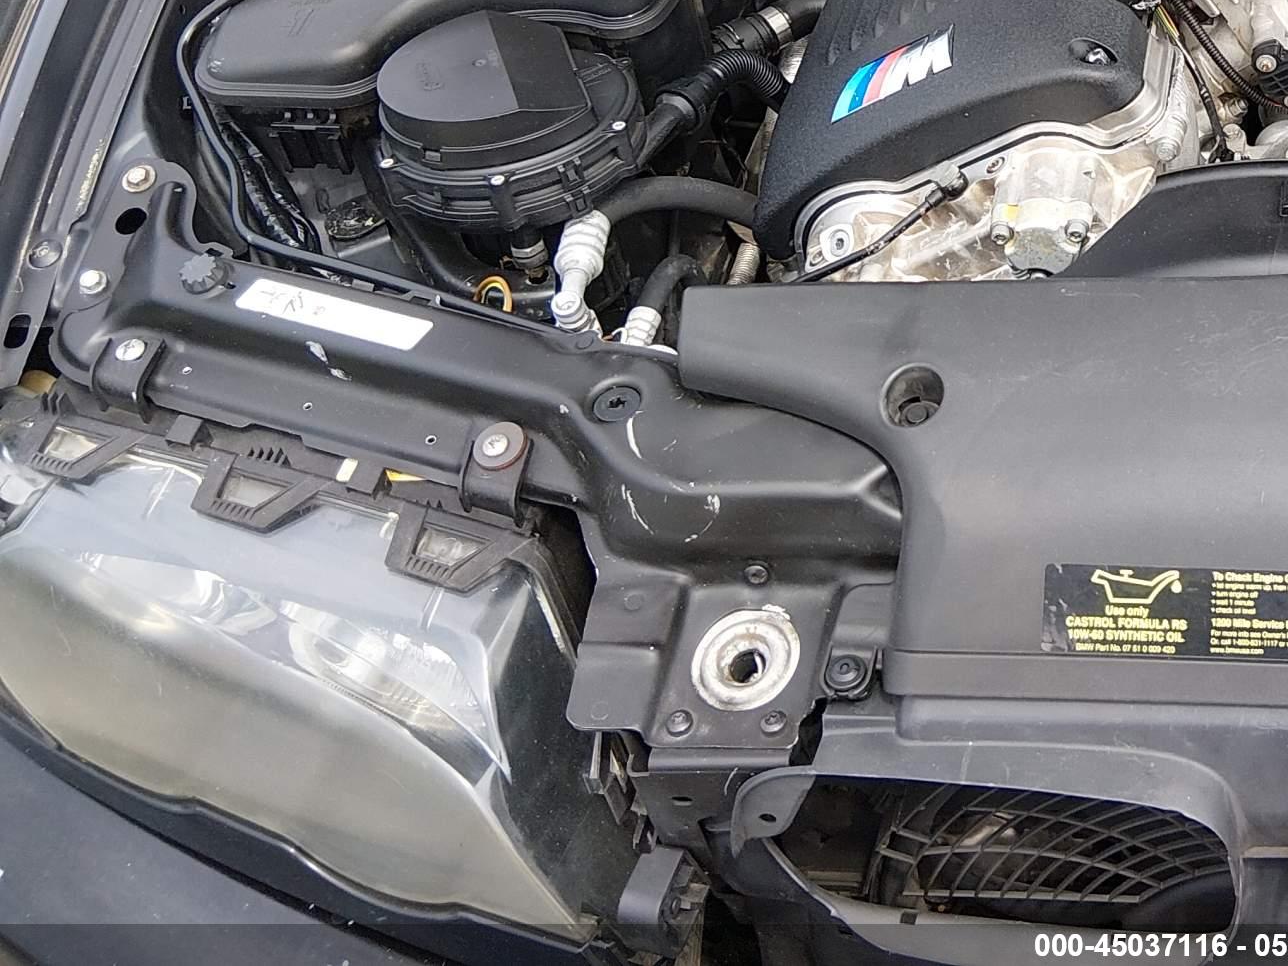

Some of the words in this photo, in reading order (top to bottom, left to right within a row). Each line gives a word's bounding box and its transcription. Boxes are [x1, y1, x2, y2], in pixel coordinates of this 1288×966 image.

[1212, 571, 1224, 581] To
[1225, 571, 1252, 582] Check
[1253, 572, 1284, 584] Engine
[1105, 605, 1125, 616] Use
[1127, 606, 1149, 618] only
[1065, 616, 1116, 628] CASTROL
[1118, 617, 1170, 630] FORMULA
[1171, 619, 1188, 631] RS
[1252, 619, 1285, 630] Service
[1067, 629, 1104, 640] 10W-60
[1106, 629, 1164, 642] SYNTHETIC
[1166, 631, 1185, 643] OIL
[1076, 643, 1094, 651] BMW
[1095, 643, 1109, 652] Part
